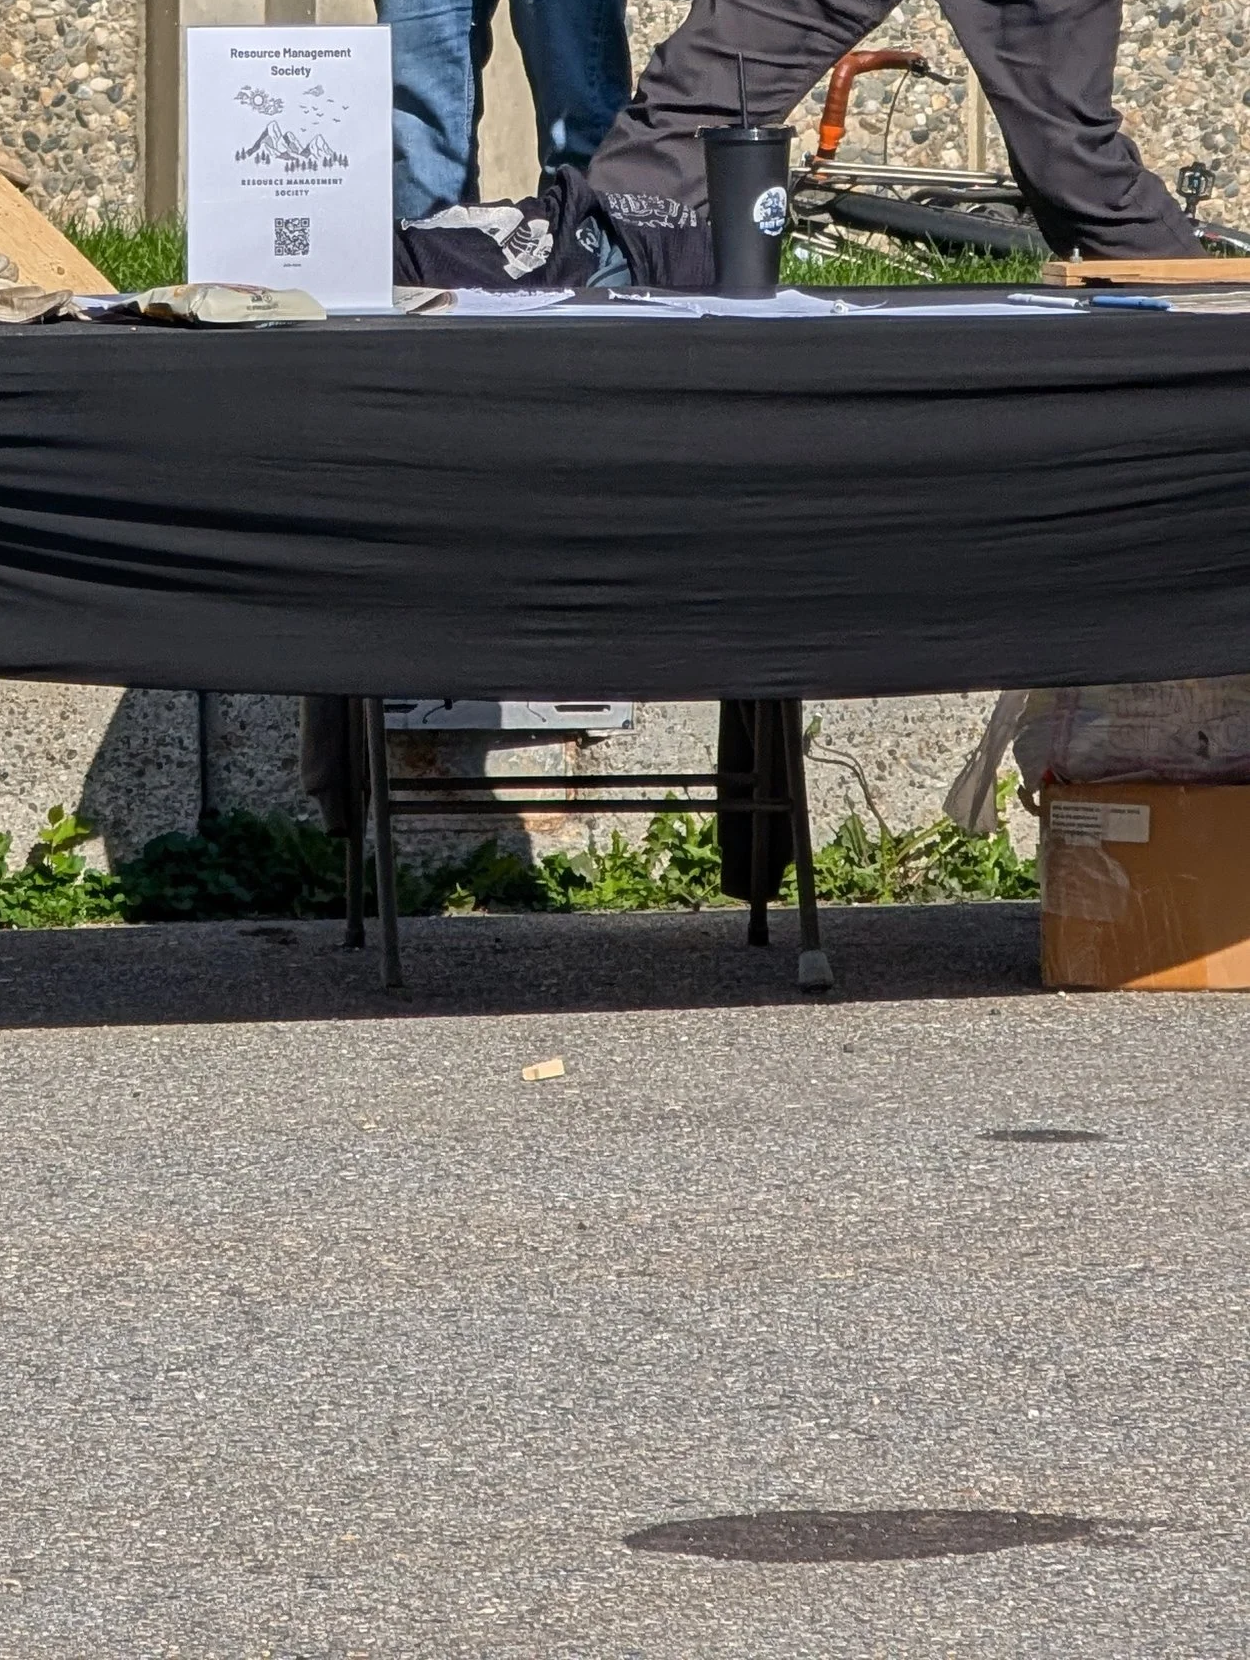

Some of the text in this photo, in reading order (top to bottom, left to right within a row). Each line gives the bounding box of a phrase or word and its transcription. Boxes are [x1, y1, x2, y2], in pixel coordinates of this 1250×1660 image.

[230, 48, 352, 60] Resource Management
[271, 65, 311, 78] Society
[241, 178, 343, 186] RESOURCE MANAGEMENT
[275, 189, 310, 197] SOCIETY
